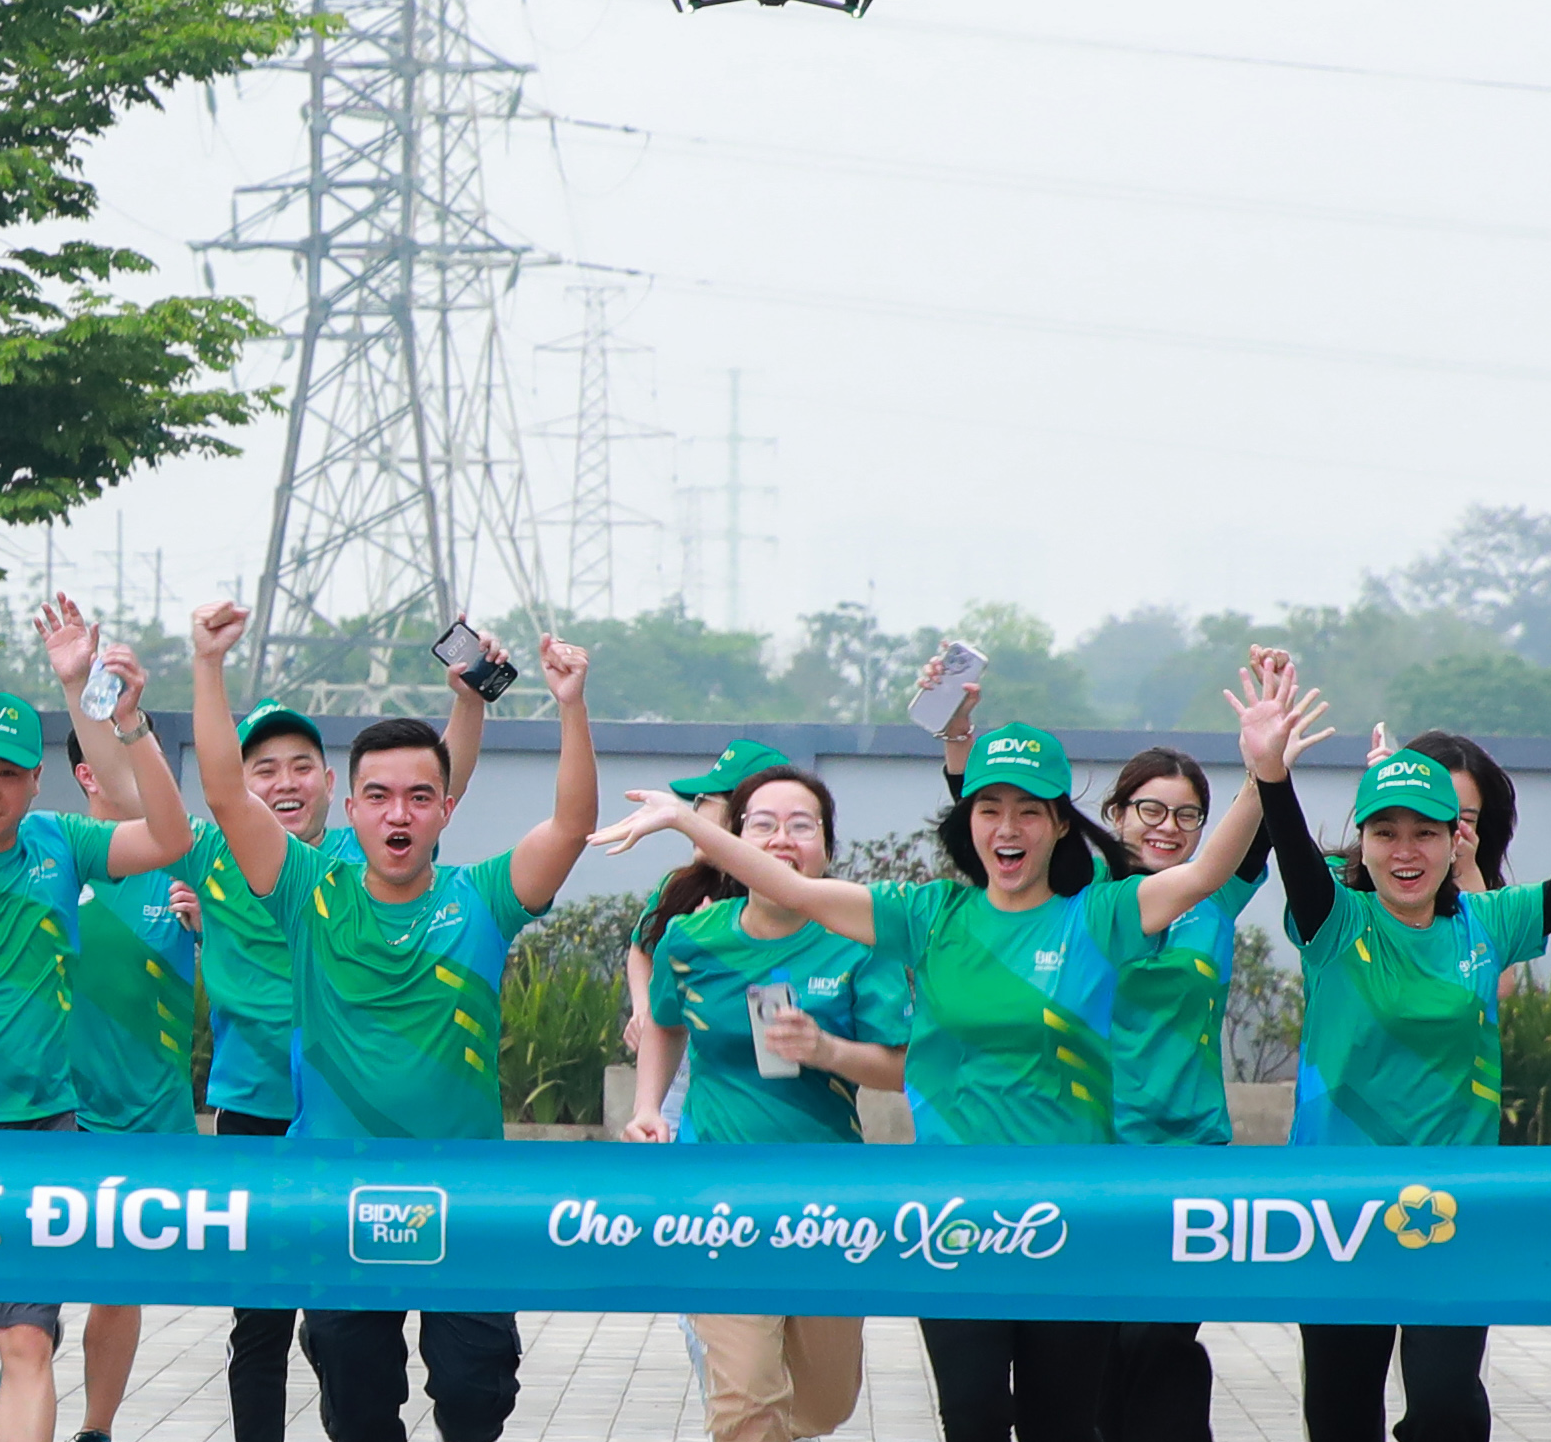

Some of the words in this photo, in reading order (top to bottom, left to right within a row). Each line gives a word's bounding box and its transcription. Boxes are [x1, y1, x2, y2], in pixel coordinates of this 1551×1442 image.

[987, 737, 1028, 755] BIDV
[1377, 760, 1417, 781] BIDV
[26, 1176, 250, 1250] ĐÍCH
[359, 1204, 411, 1222] BIDV
[373, 1224, 418, 1243] Run
[549, 1199, 642, 1246] Cho
[654, 1202, 760, 1258] cuộc
[770, 1203, 886, 1263] sống
[1172, 1198, 1384, 1261] BIDV
